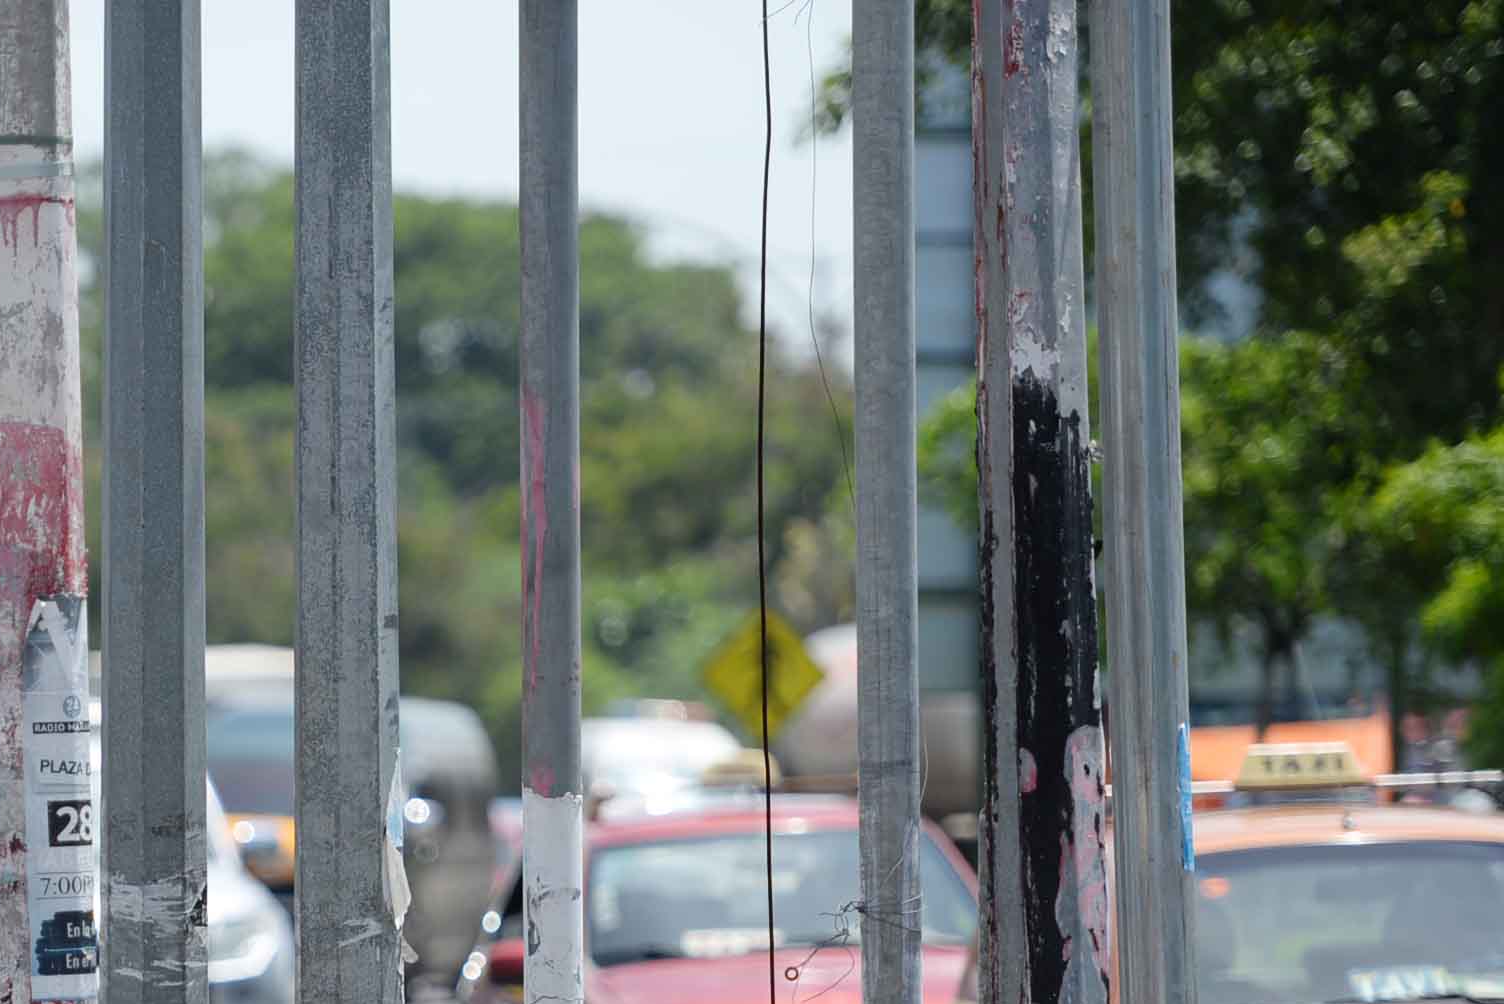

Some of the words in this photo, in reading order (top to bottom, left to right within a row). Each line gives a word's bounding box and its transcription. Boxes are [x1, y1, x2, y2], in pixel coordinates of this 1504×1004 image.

[34, 723, 66, 733] RADIO
[39, 759, 83, 775] PLAZA
[56, 805, 93, 842] 28
[66, 922, 81, 938] En
[65, 953, 80, 969] En
